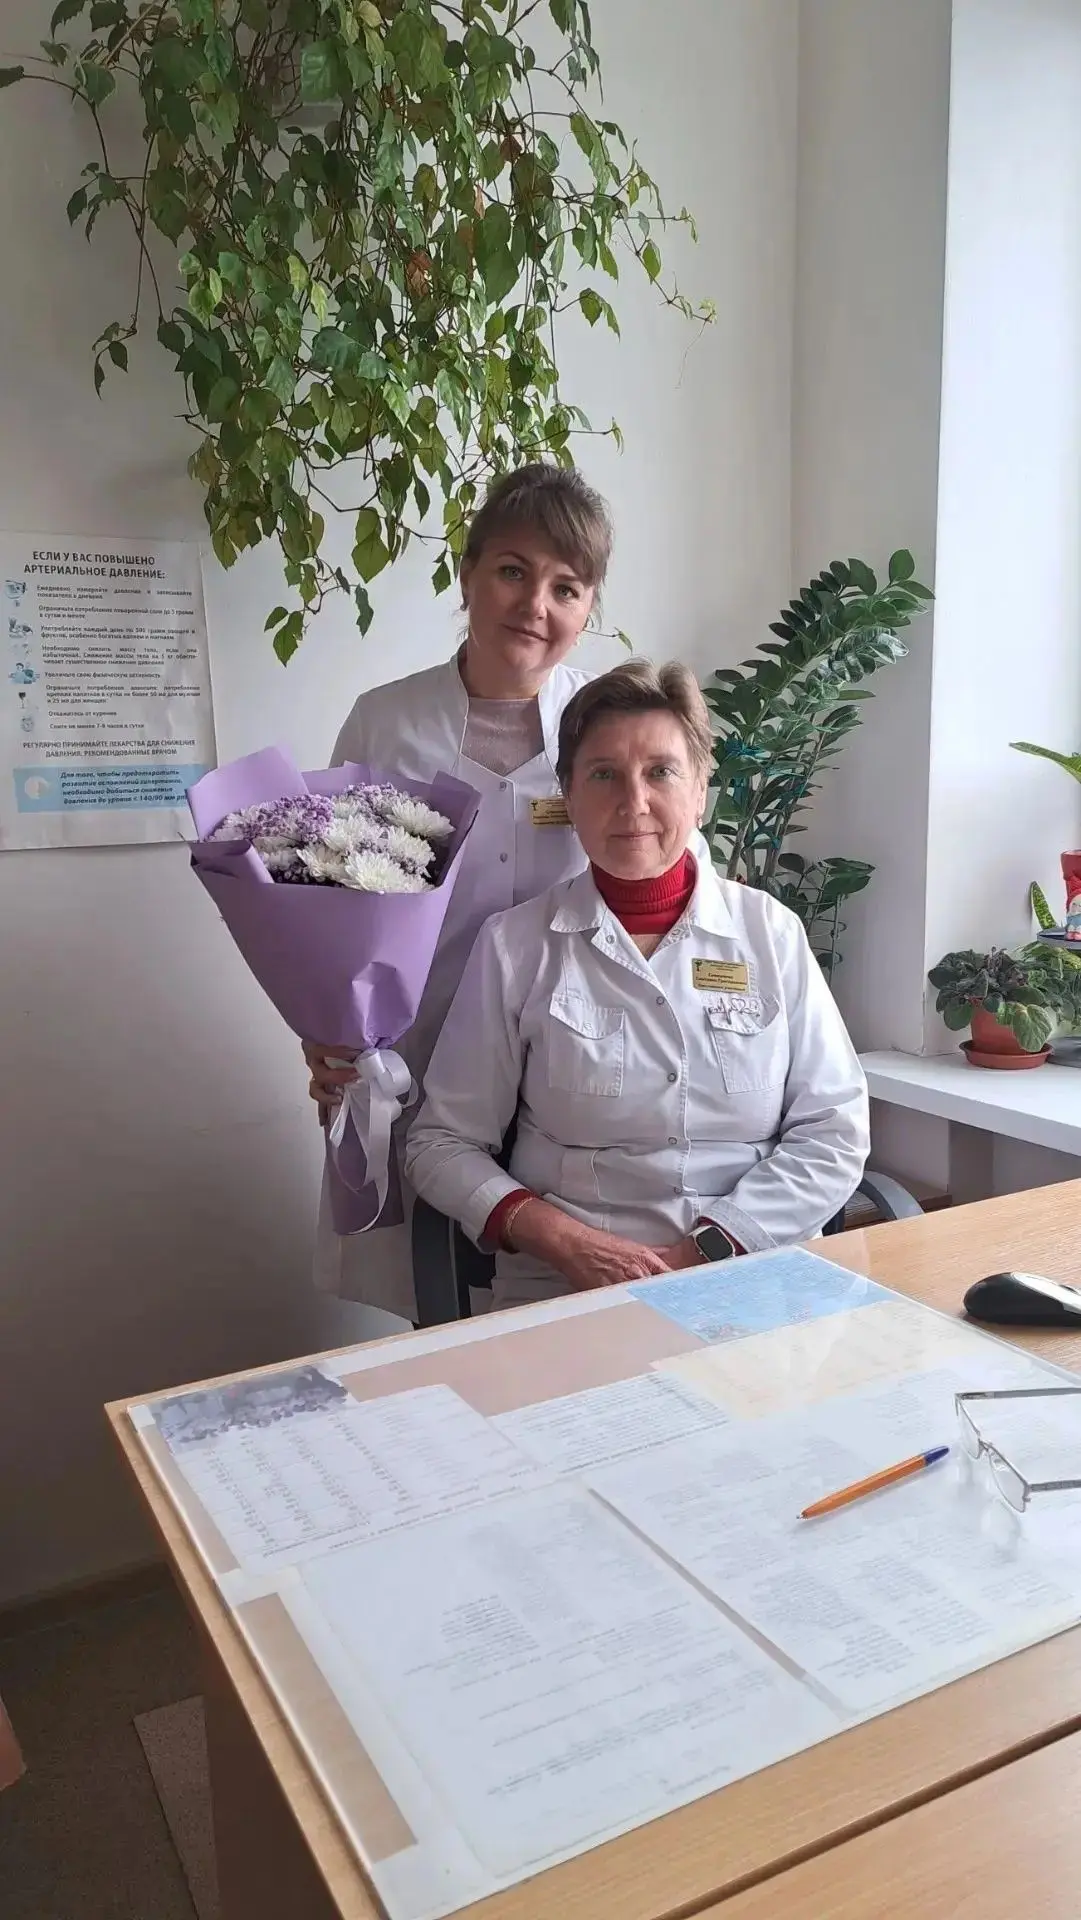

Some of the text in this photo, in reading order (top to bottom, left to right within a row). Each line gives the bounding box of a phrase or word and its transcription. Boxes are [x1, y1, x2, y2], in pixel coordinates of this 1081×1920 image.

[33, 551, 155, 566] ЕСЛИ У ВАС ПОВЫШЕНО
[24, 564, 166, 578] АРТЕРИАЛЬНОЕ ДАВЛЕНИЕ:
[62, 740, 108, 748] ПРИНИМАЙТЕ
